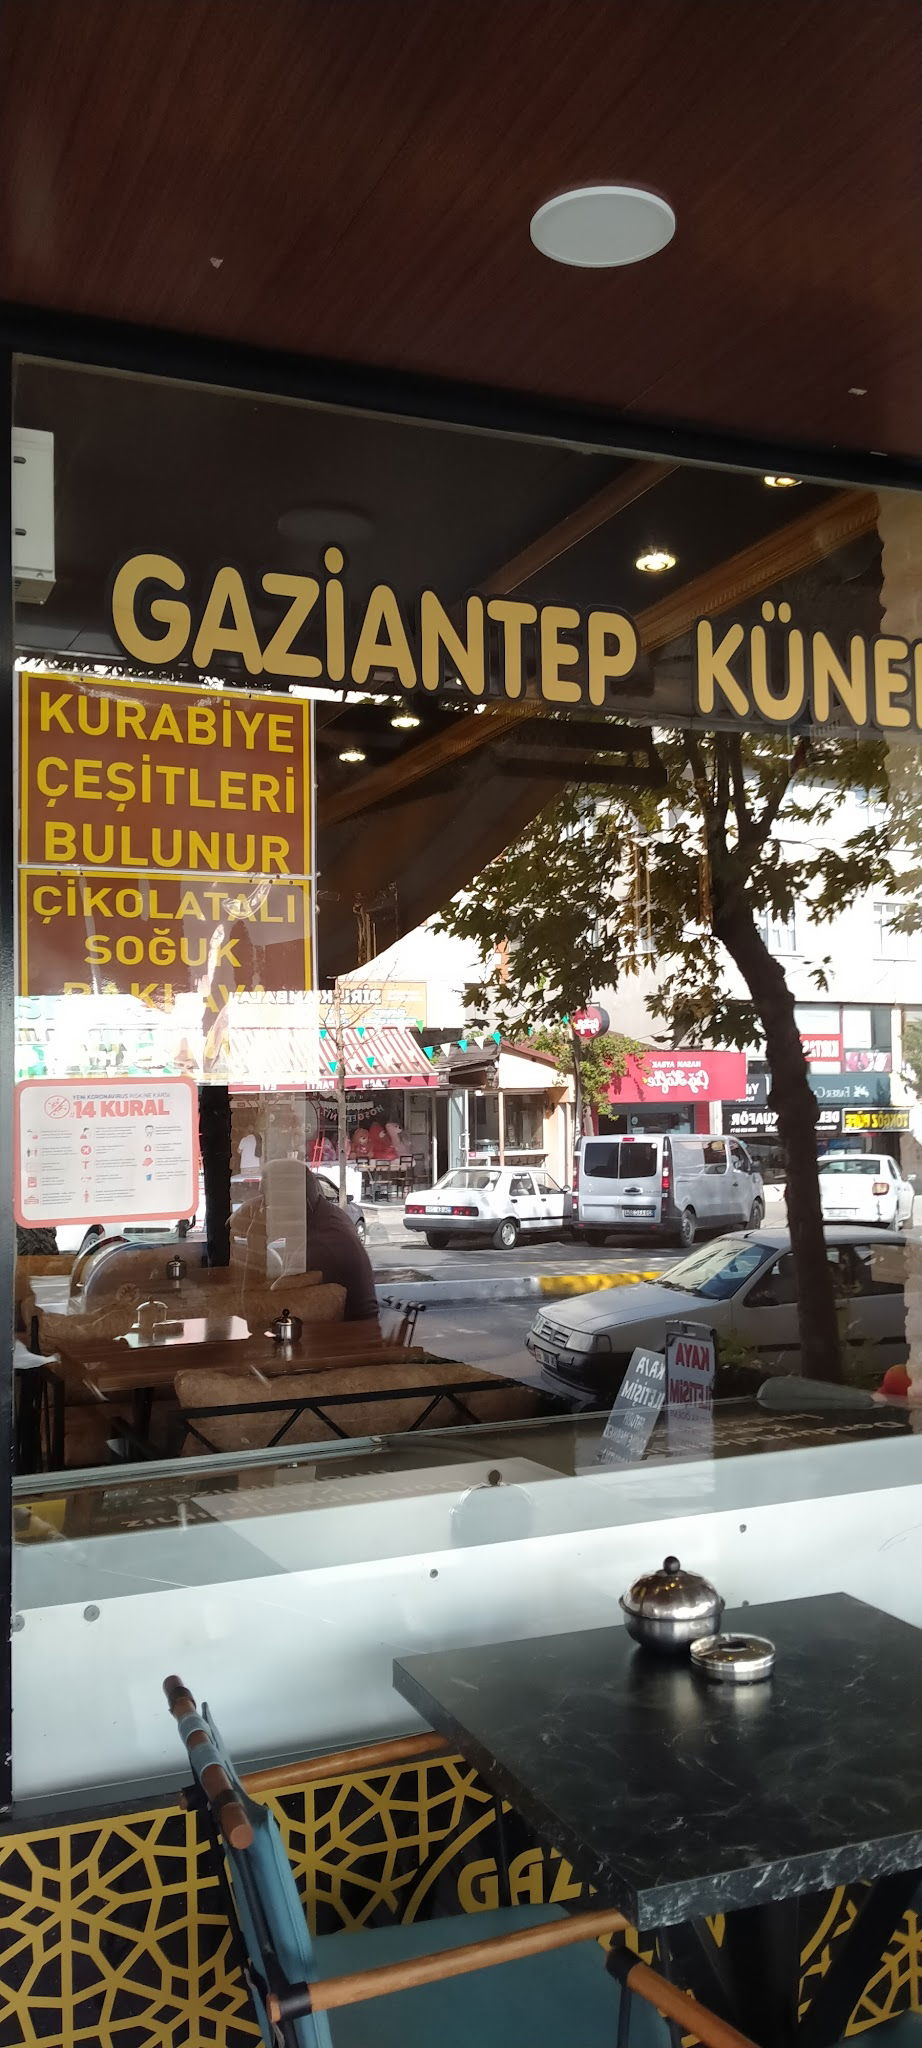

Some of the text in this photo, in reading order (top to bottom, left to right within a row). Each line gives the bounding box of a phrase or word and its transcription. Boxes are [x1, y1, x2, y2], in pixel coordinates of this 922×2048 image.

[112, 547, 922, 727] GAZİANTEP KÜNE
[39, 690, 295, 753] KURABİYE
[36, 754, 296, 814] ÇEŞİTLERİ
[44, 821, 291, 873] BULUNUR
[32, 879, 297, 925] ÇİKOLATALI
[84, 927, 242, 968] SOĞUK
[72, 1099, 170, 1119] 14 KURAL
